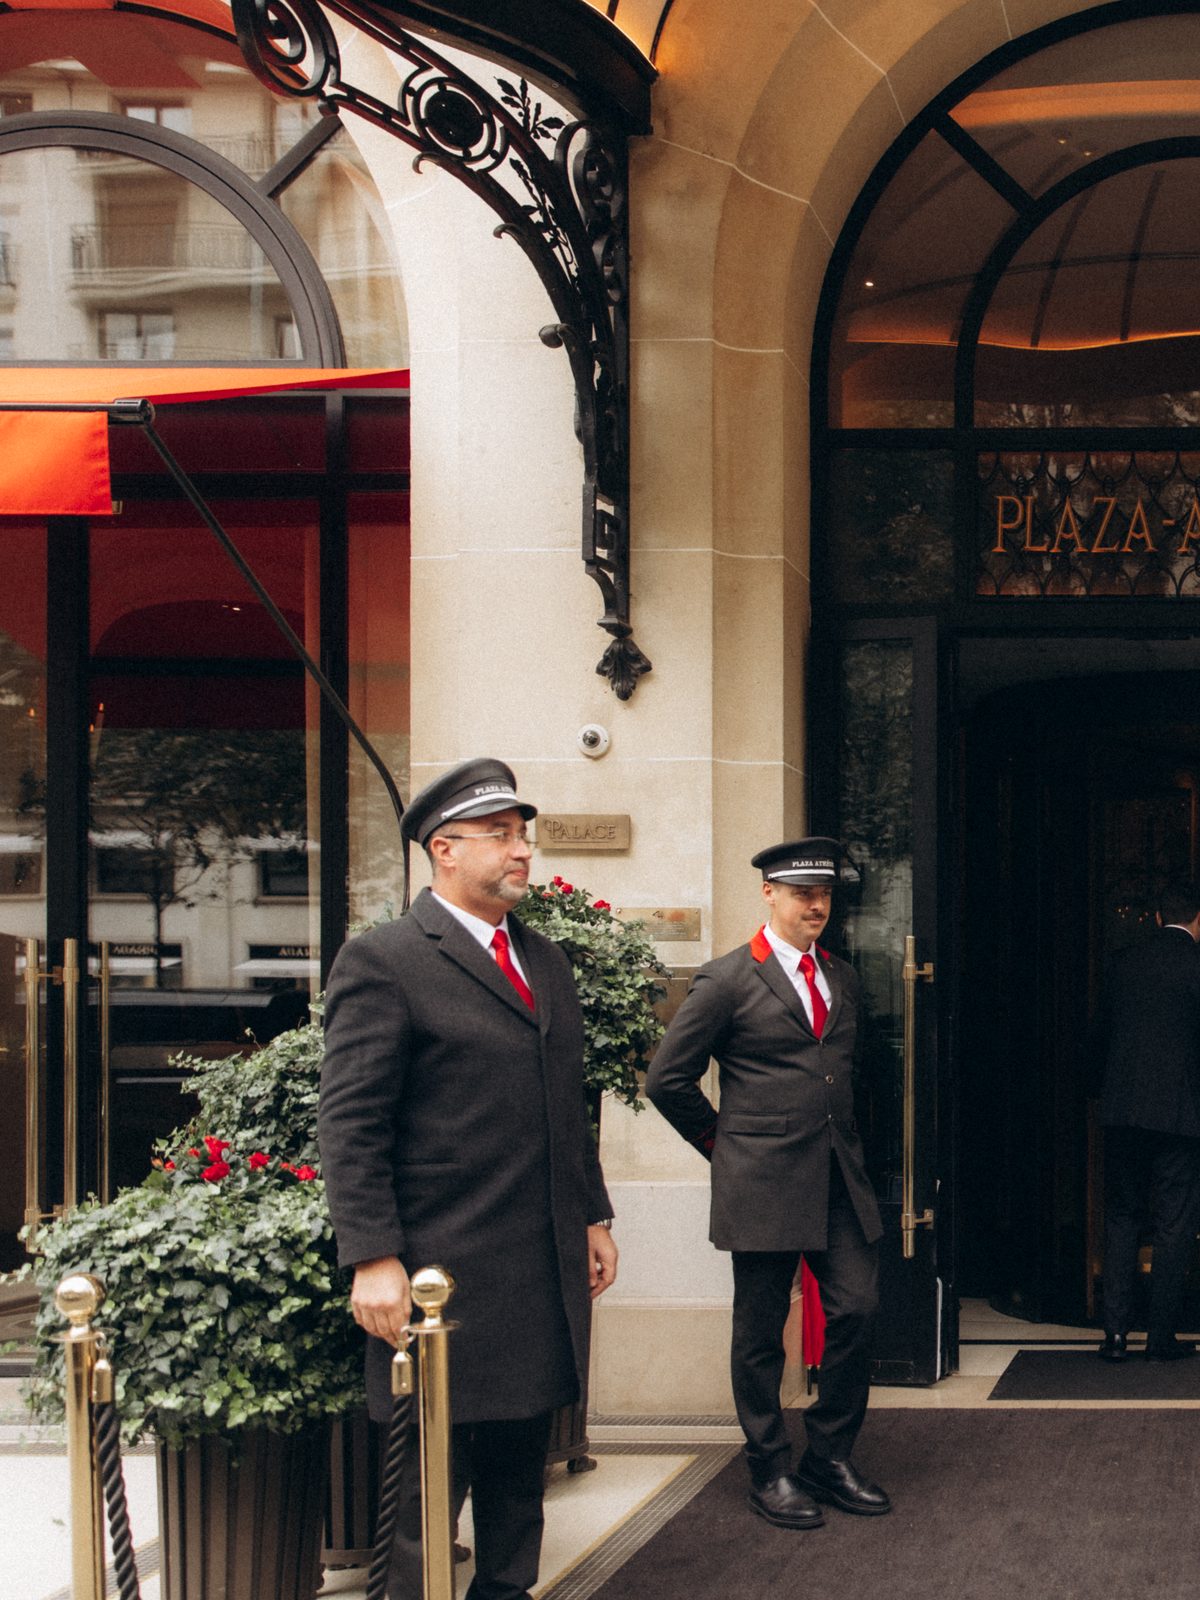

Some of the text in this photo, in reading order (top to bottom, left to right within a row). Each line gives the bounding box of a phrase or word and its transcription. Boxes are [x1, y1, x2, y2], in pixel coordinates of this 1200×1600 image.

[474, 785, 500, 795] PLAZA
[543, 820, 617, 840] PALACE
[792, 860, 813, 868] PLAZA
